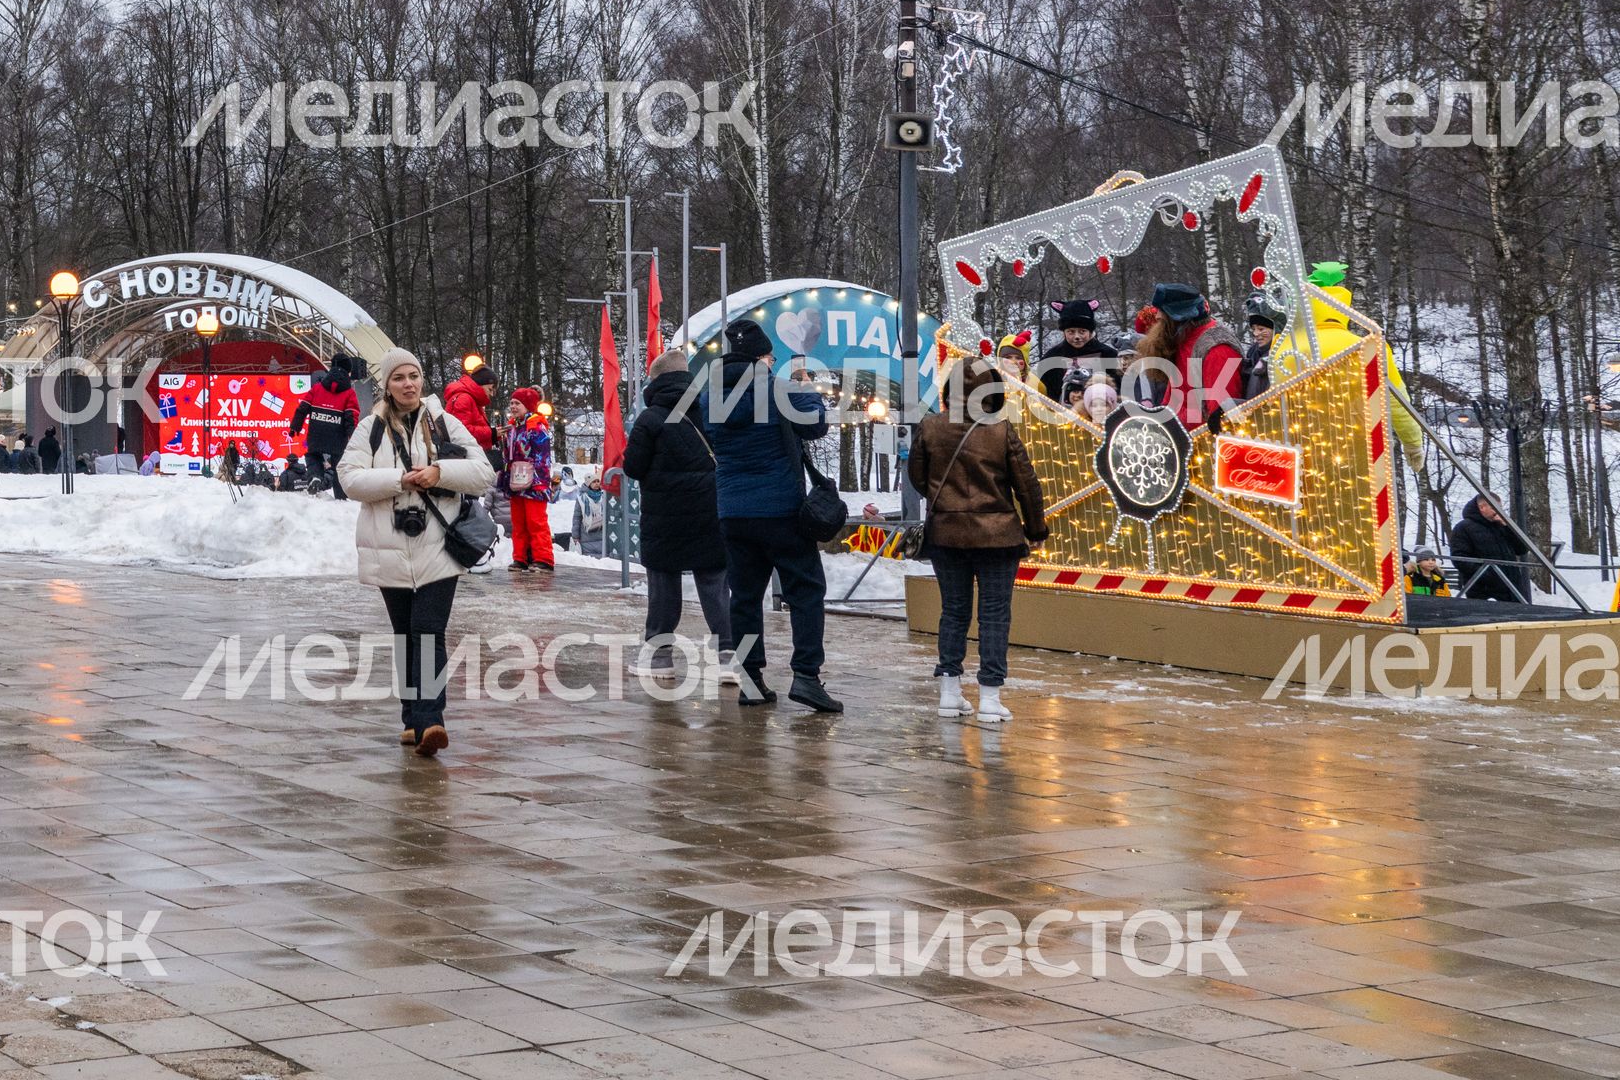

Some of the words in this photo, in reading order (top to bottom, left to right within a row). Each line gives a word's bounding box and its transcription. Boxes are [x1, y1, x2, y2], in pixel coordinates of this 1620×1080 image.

[83, 280, 108, 308] С
[119, 266, 273, 312] НОВЫМ
[217, 398, 252, 417] XIV
[230, 418, 291, 428] Новогодний
